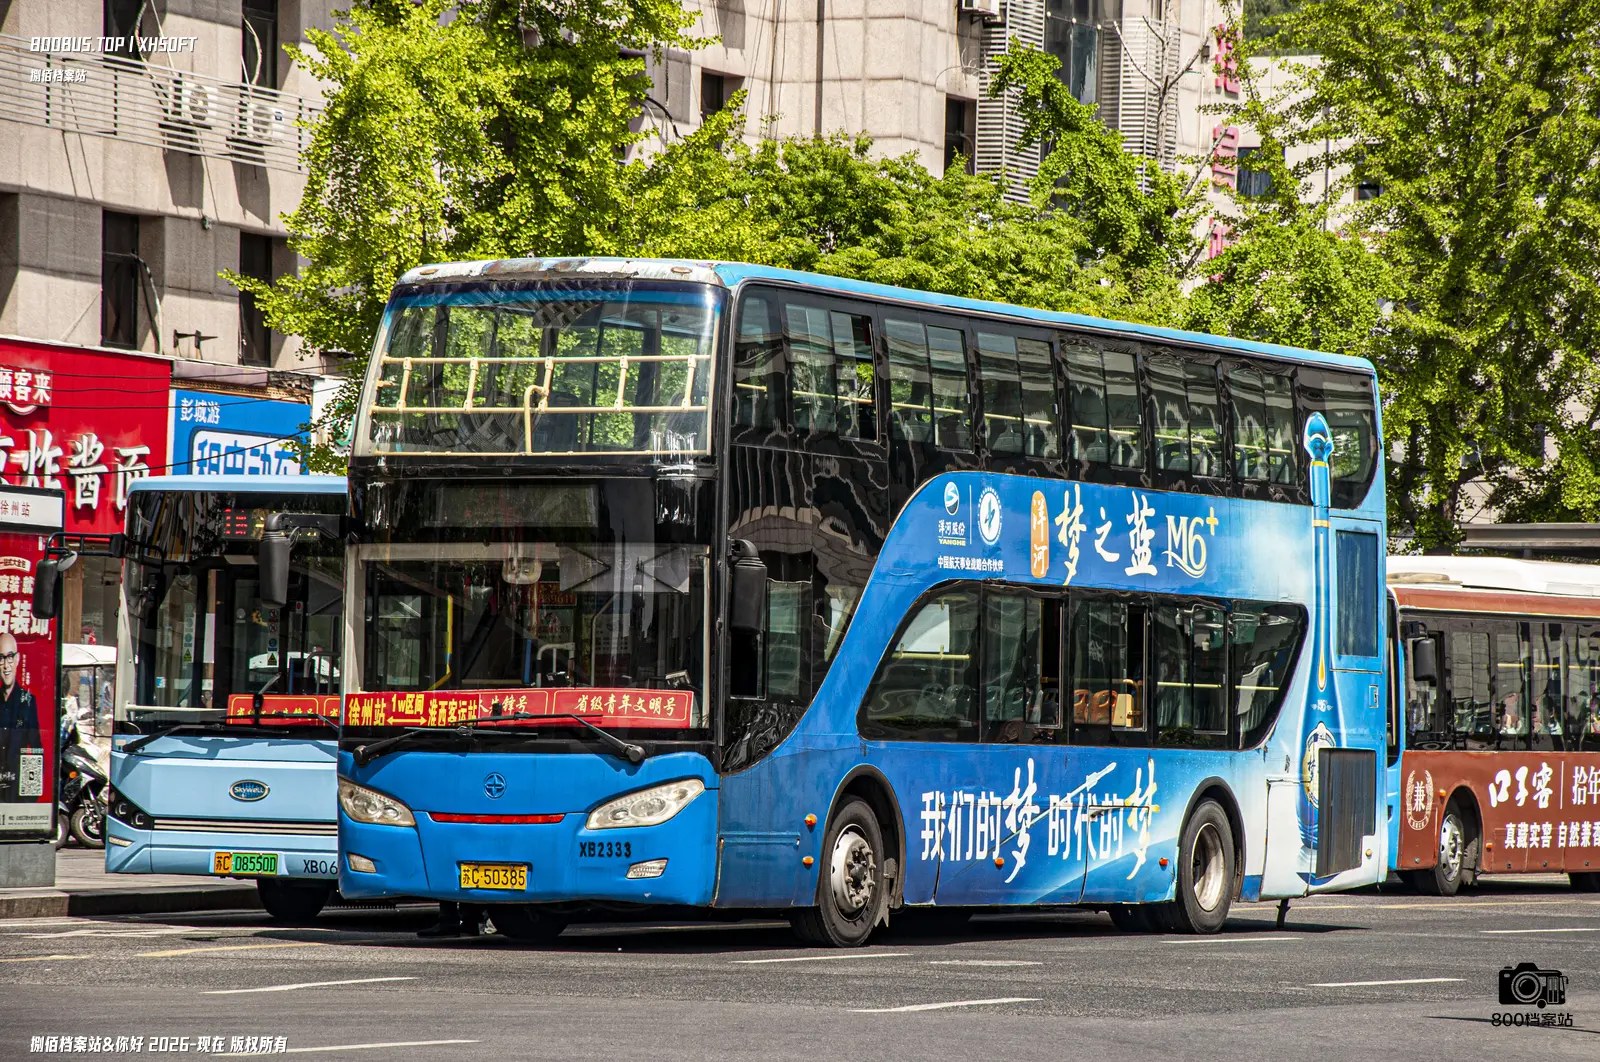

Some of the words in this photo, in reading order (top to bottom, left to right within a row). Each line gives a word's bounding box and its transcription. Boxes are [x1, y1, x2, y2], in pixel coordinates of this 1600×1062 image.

[180, 397, 220, 424] 彭城游
[938, 538, 966, 547] YANGHE
[1055, 483, 1158, 586] 梦之蓝
[348, 698, 387, 726] 徐州站
[574, 694, 677, 717] 省级青年文明号
[920, 757, 1041, 884] 我们的梦
[1049, 758, 1161, 881] 时代的梦
[579, 841, 632, 859] XB2333
[303, 859, 338, 875] XB06
